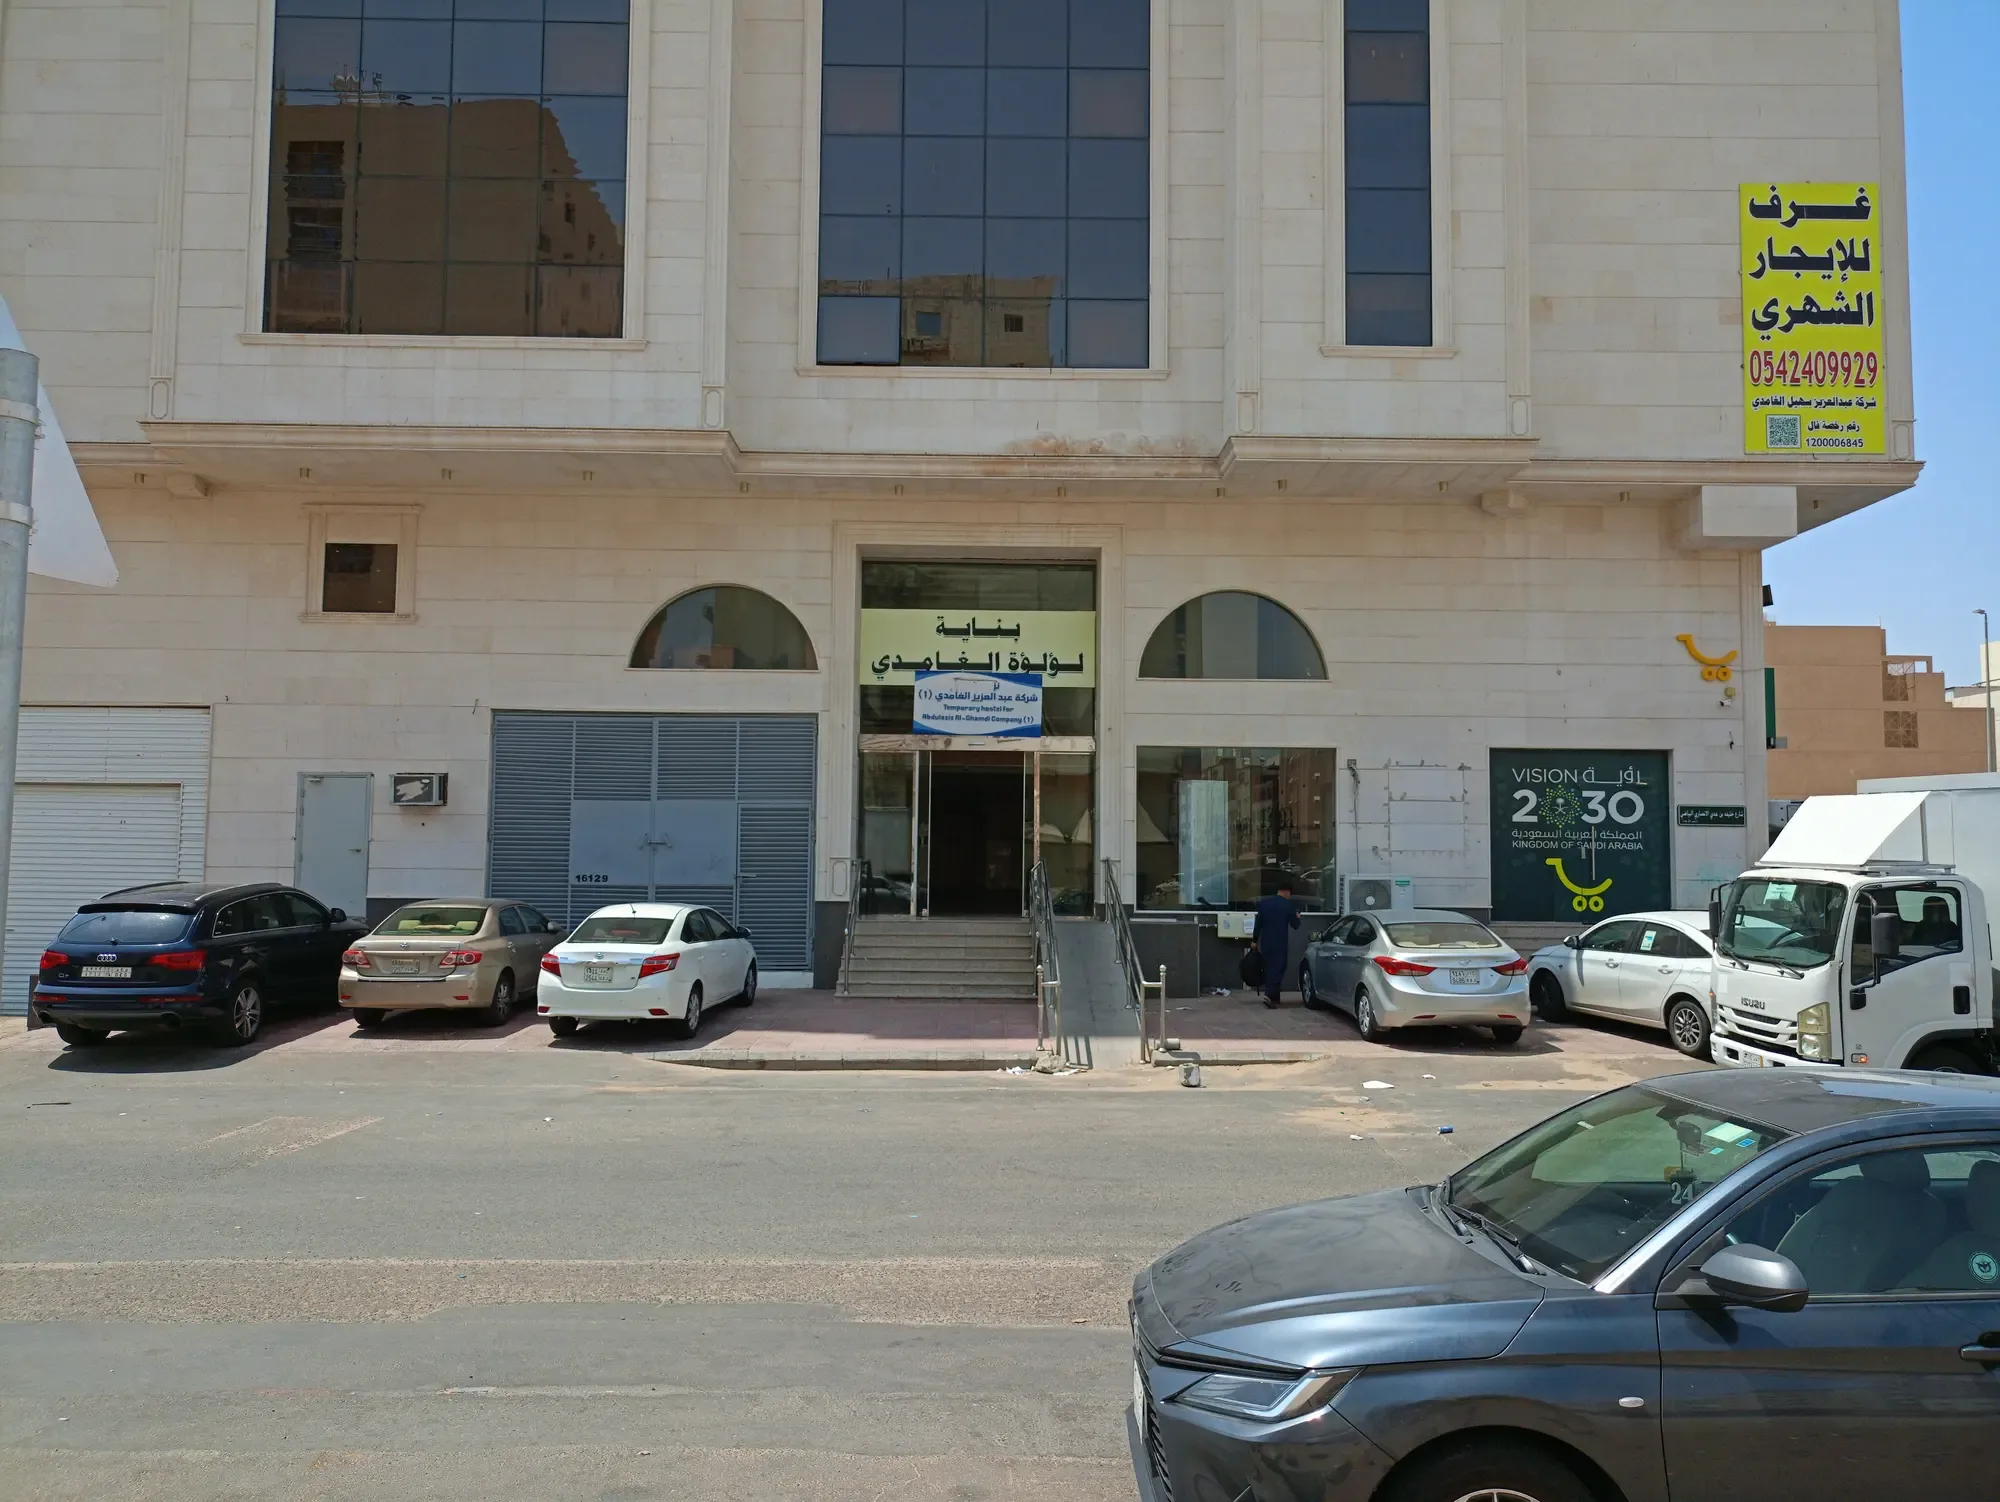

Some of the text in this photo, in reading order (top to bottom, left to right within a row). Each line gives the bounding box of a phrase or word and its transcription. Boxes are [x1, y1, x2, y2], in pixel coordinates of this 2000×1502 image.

[1749, 185, 1871, 228] غرف
[1748, 237, 1870, 283] للإيجار
[1751, 290, 1874, 341] الشهري
[1750, 350, 1878, 387] 0542409929
[1752, 396, 1785, 411] الغامدي
[1787, 396, 1812, 408] سهيل
[1855, 396, 1876, 409] شركة
[1807, 421, 1860, 432] رقم رخصة فال
[1806, 438, 1864, 447] 1200006845
[936, 616, 1020, 643] بناية
[872, 651, 1084, 680] لؤلؤة الغامدي
[935, 692, 970, 702] الغامدي
[971, 692, 996, 702] العزيز
[998, 694, 1013, 703] عبد
[1015, 693, 1038, 703] شركة
[943, 704, 980, 713] Temporary
[981, 704, 1002, 712] hostel
[991, 716, 1022, 724] Company
[1512, 768, 1578, 783] VISION
[1582, 766, 1645, 787] رؤية
[1512, 829, 1562, 840] السعودية
[1600, 830, 1642, 840] المملكة
[1512, 841, 1643, 850] KINGDOM OF SAUDI ARABIA
[575, 874, 609, 883] 16129
[1741, 997, 1765, 1010] ISUZU
